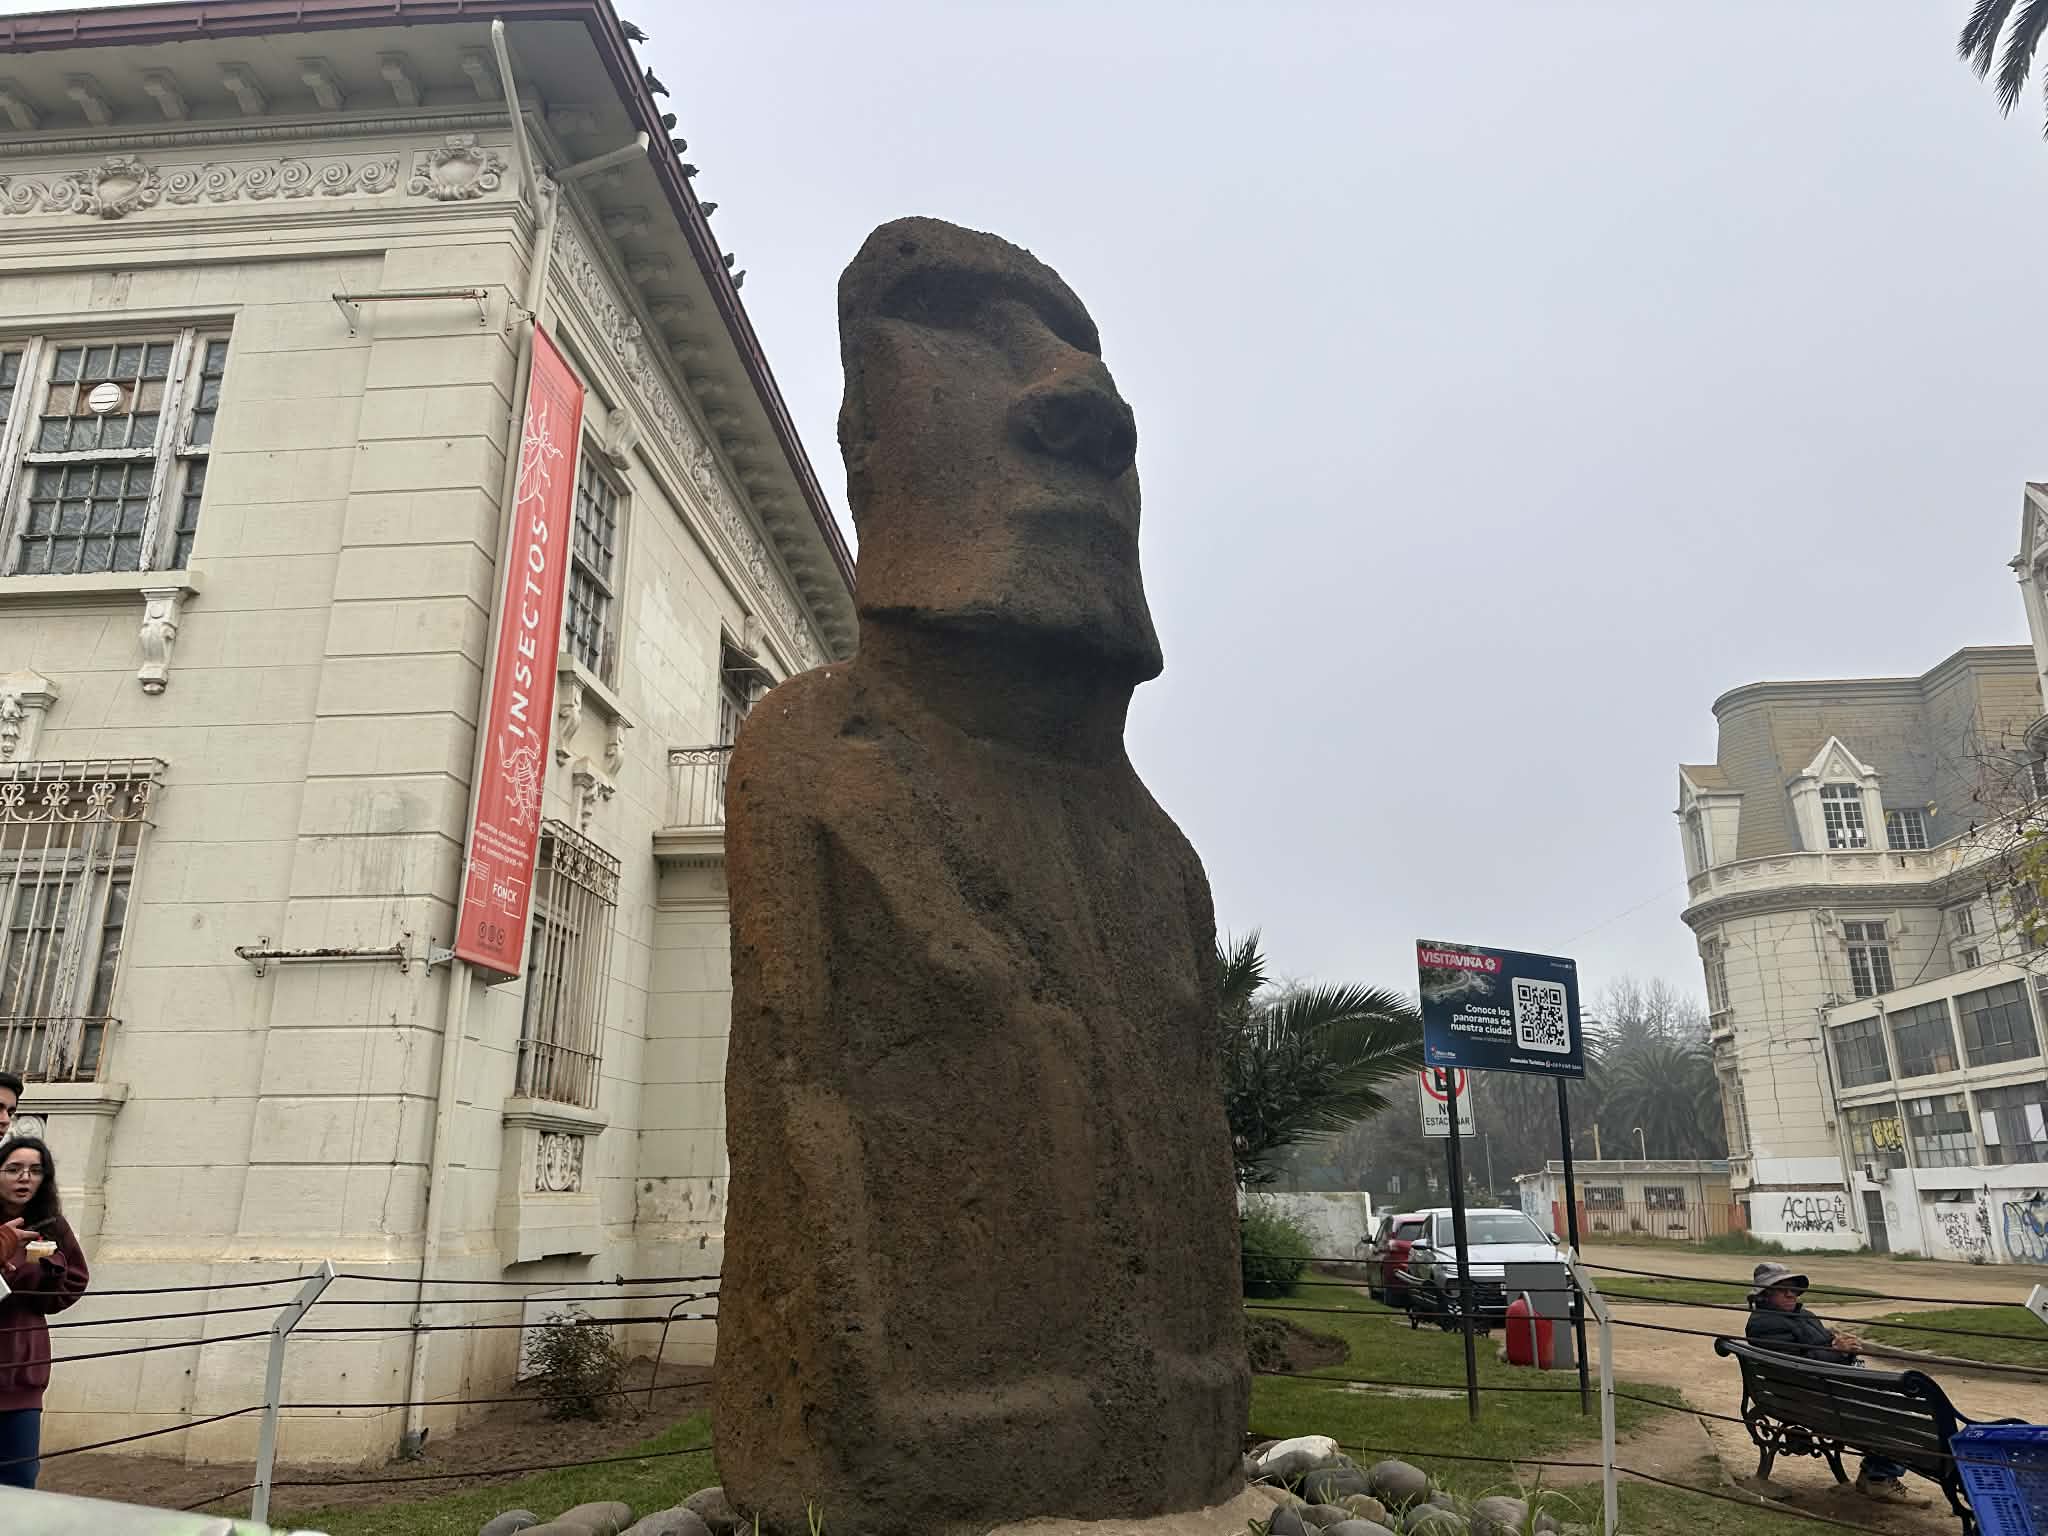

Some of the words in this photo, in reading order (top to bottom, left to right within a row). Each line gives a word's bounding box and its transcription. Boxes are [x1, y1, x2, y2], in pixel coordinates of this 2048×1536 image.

[508, 514, 548, 738] INSECTOS
[492, 882, 518, 904] FONCK
[1465, 1003, 1497, 1015] Conoce
[1497, 1006, 1511, 1017] los
[1453, 1014, 1500, 1025] panoramas
[1500, 1017, 1511, 1026] de
[1450, 1023, 1484, 1033] nuestra
[1485, 1025, 1513, 1036] ciudad
[1425, 1116, 1471, 1126] ESTACAR
[1781, 1196, 1835, 1222] ACAB
